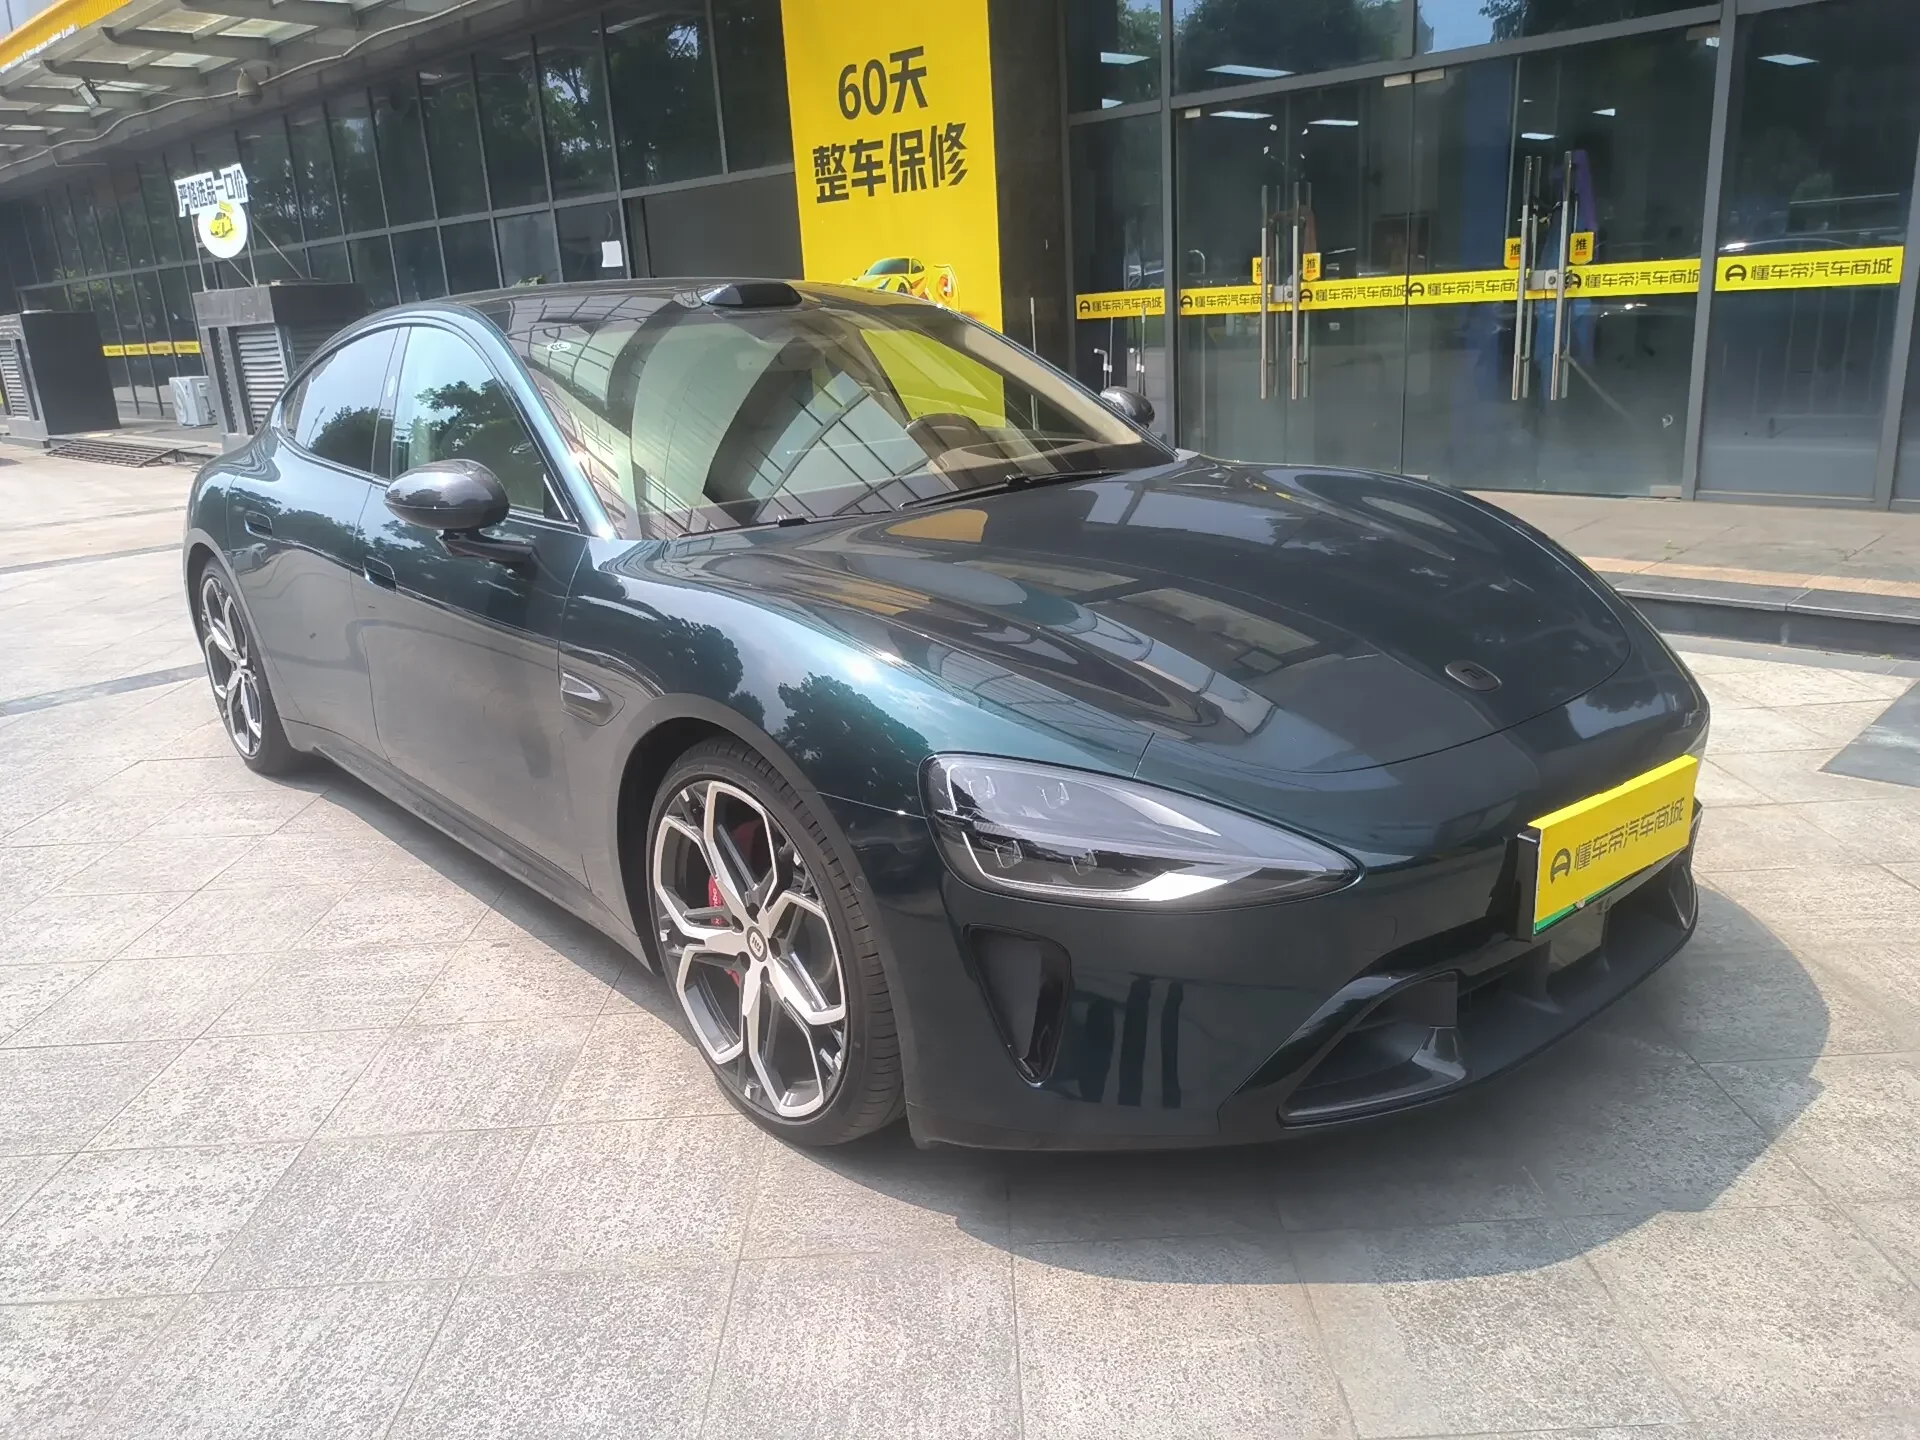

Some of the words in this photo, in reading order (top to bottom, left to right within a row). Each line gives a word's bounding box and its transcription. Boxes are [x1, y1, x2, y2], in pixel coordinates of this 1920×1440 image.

[837, 45, 929, 120] 60天
[811, 122, 969, 204] 整车保修
[177, 168, 247, 212] 严格选品一口价
[1575, 238, 1588, 251] 推
[1751, 257, 1893, 281] 懂车帝汽车商城
[1194, 292, 1271, 308] 懂车帝汽车商
[1427, 278, 1519, 297] 懂车帝汽车商
[1574, 796, 1686, 871] 懂车帝汽车商城
